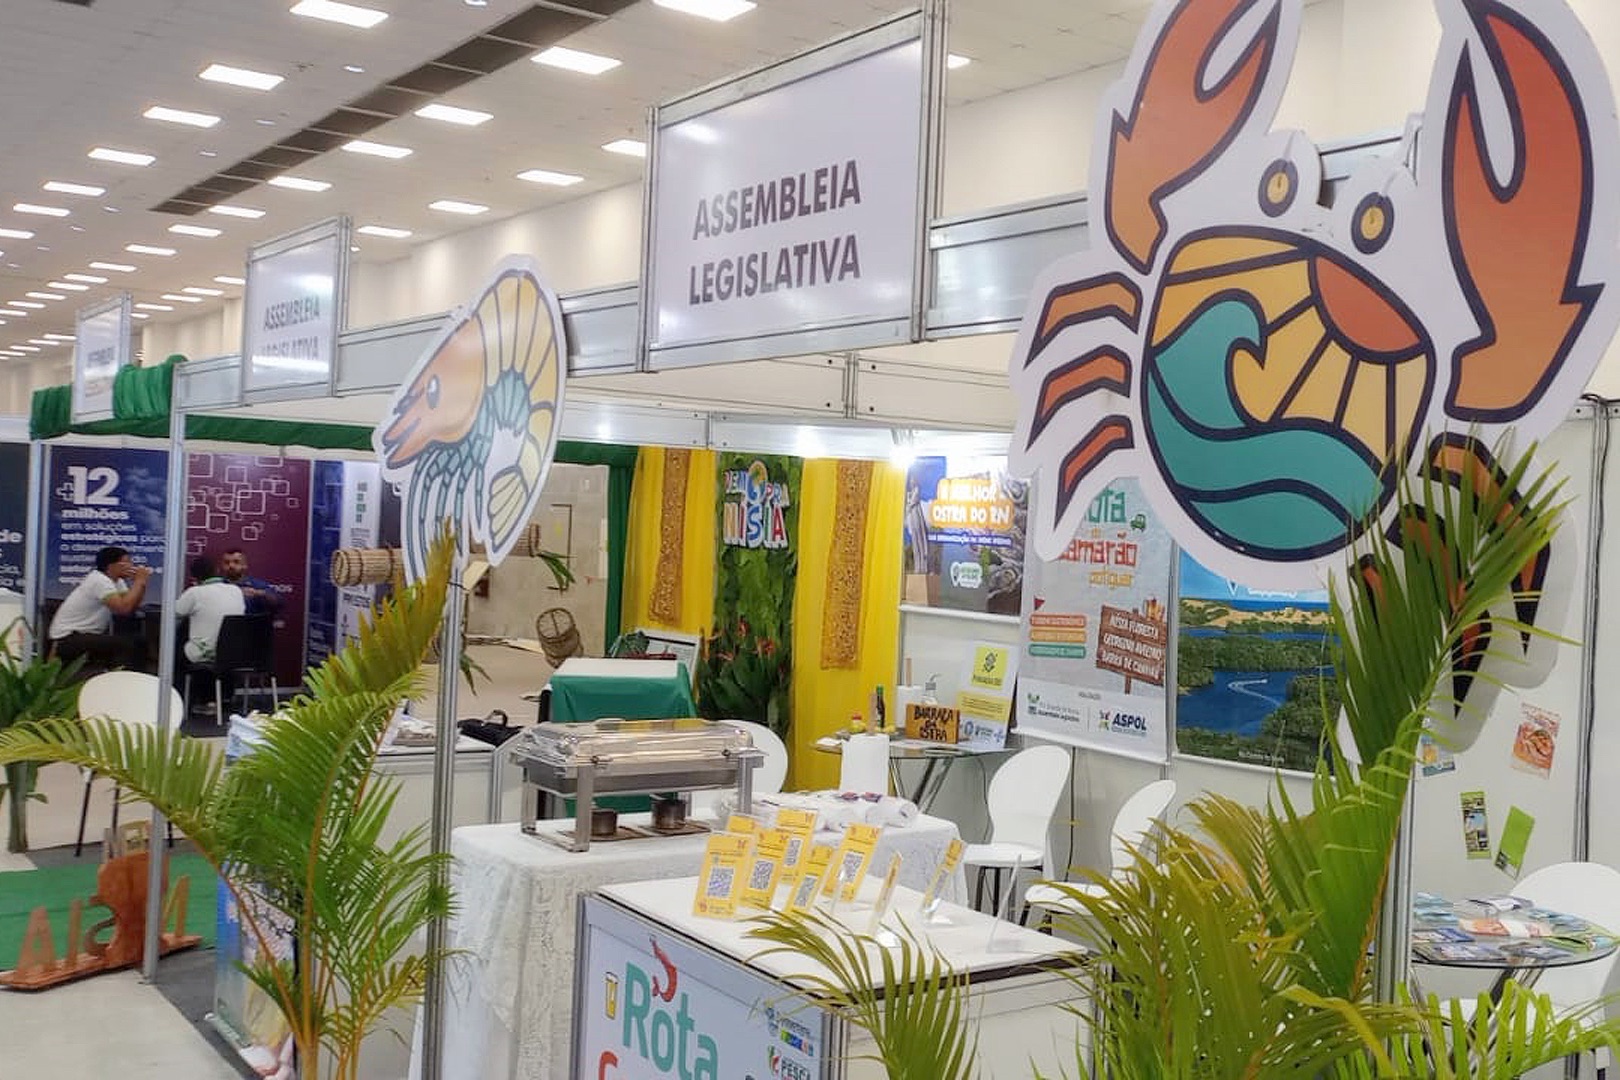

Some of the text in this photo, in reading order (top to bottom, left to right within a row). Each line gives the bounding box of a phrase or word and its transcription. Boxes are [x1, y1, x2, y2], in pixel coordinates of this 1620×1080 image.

[693, 160, 861, 240] ASSEMBLEIA
[689, 235, 861, 305] LEGISLATIVA
[61, 507, 130, 520] milhões
[84, 520, 137, 535] soluções
[1111, 712, 1147, 731] ASPOL
[623, 961, 719, 1080] Rota
